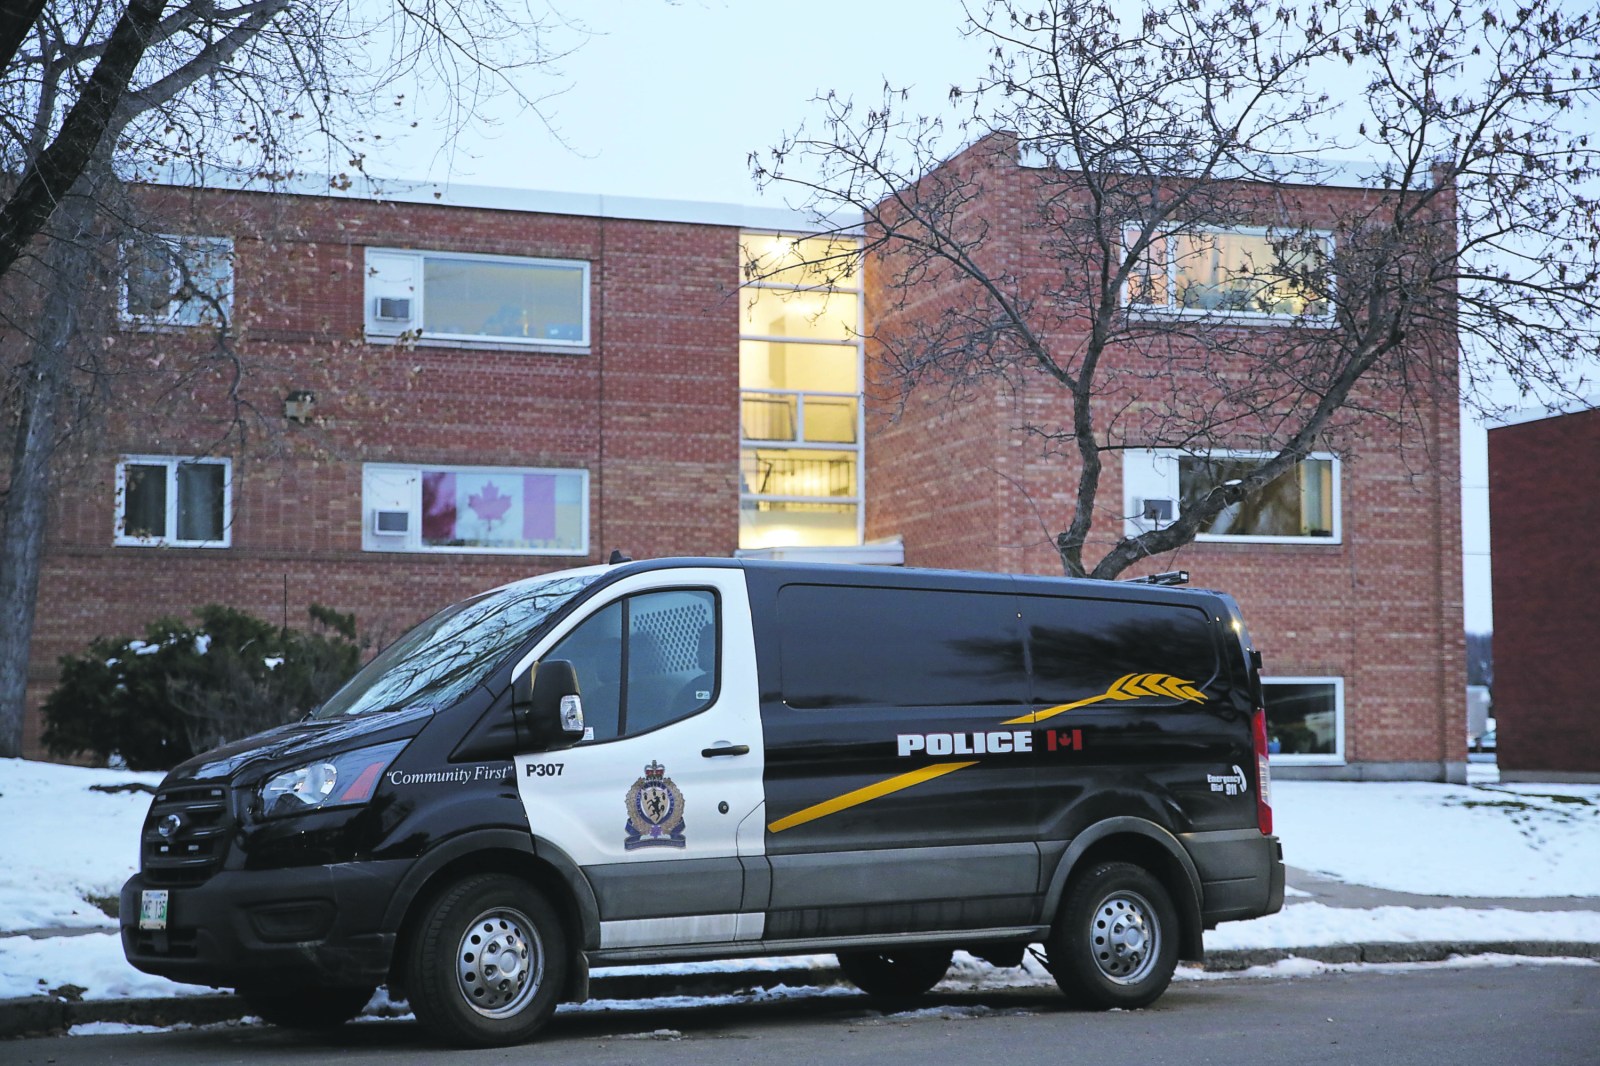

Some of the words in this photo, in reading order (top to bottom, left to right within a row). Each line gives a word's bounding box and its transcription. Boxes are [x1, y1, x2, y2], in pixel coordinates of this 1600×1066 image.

[897, 731, 1033, 757] POLICE
[525, 763, 565, 777] P307
[1207, 774, 1240, 784] Emergency
[1226, 784, 1237, 795] 911
